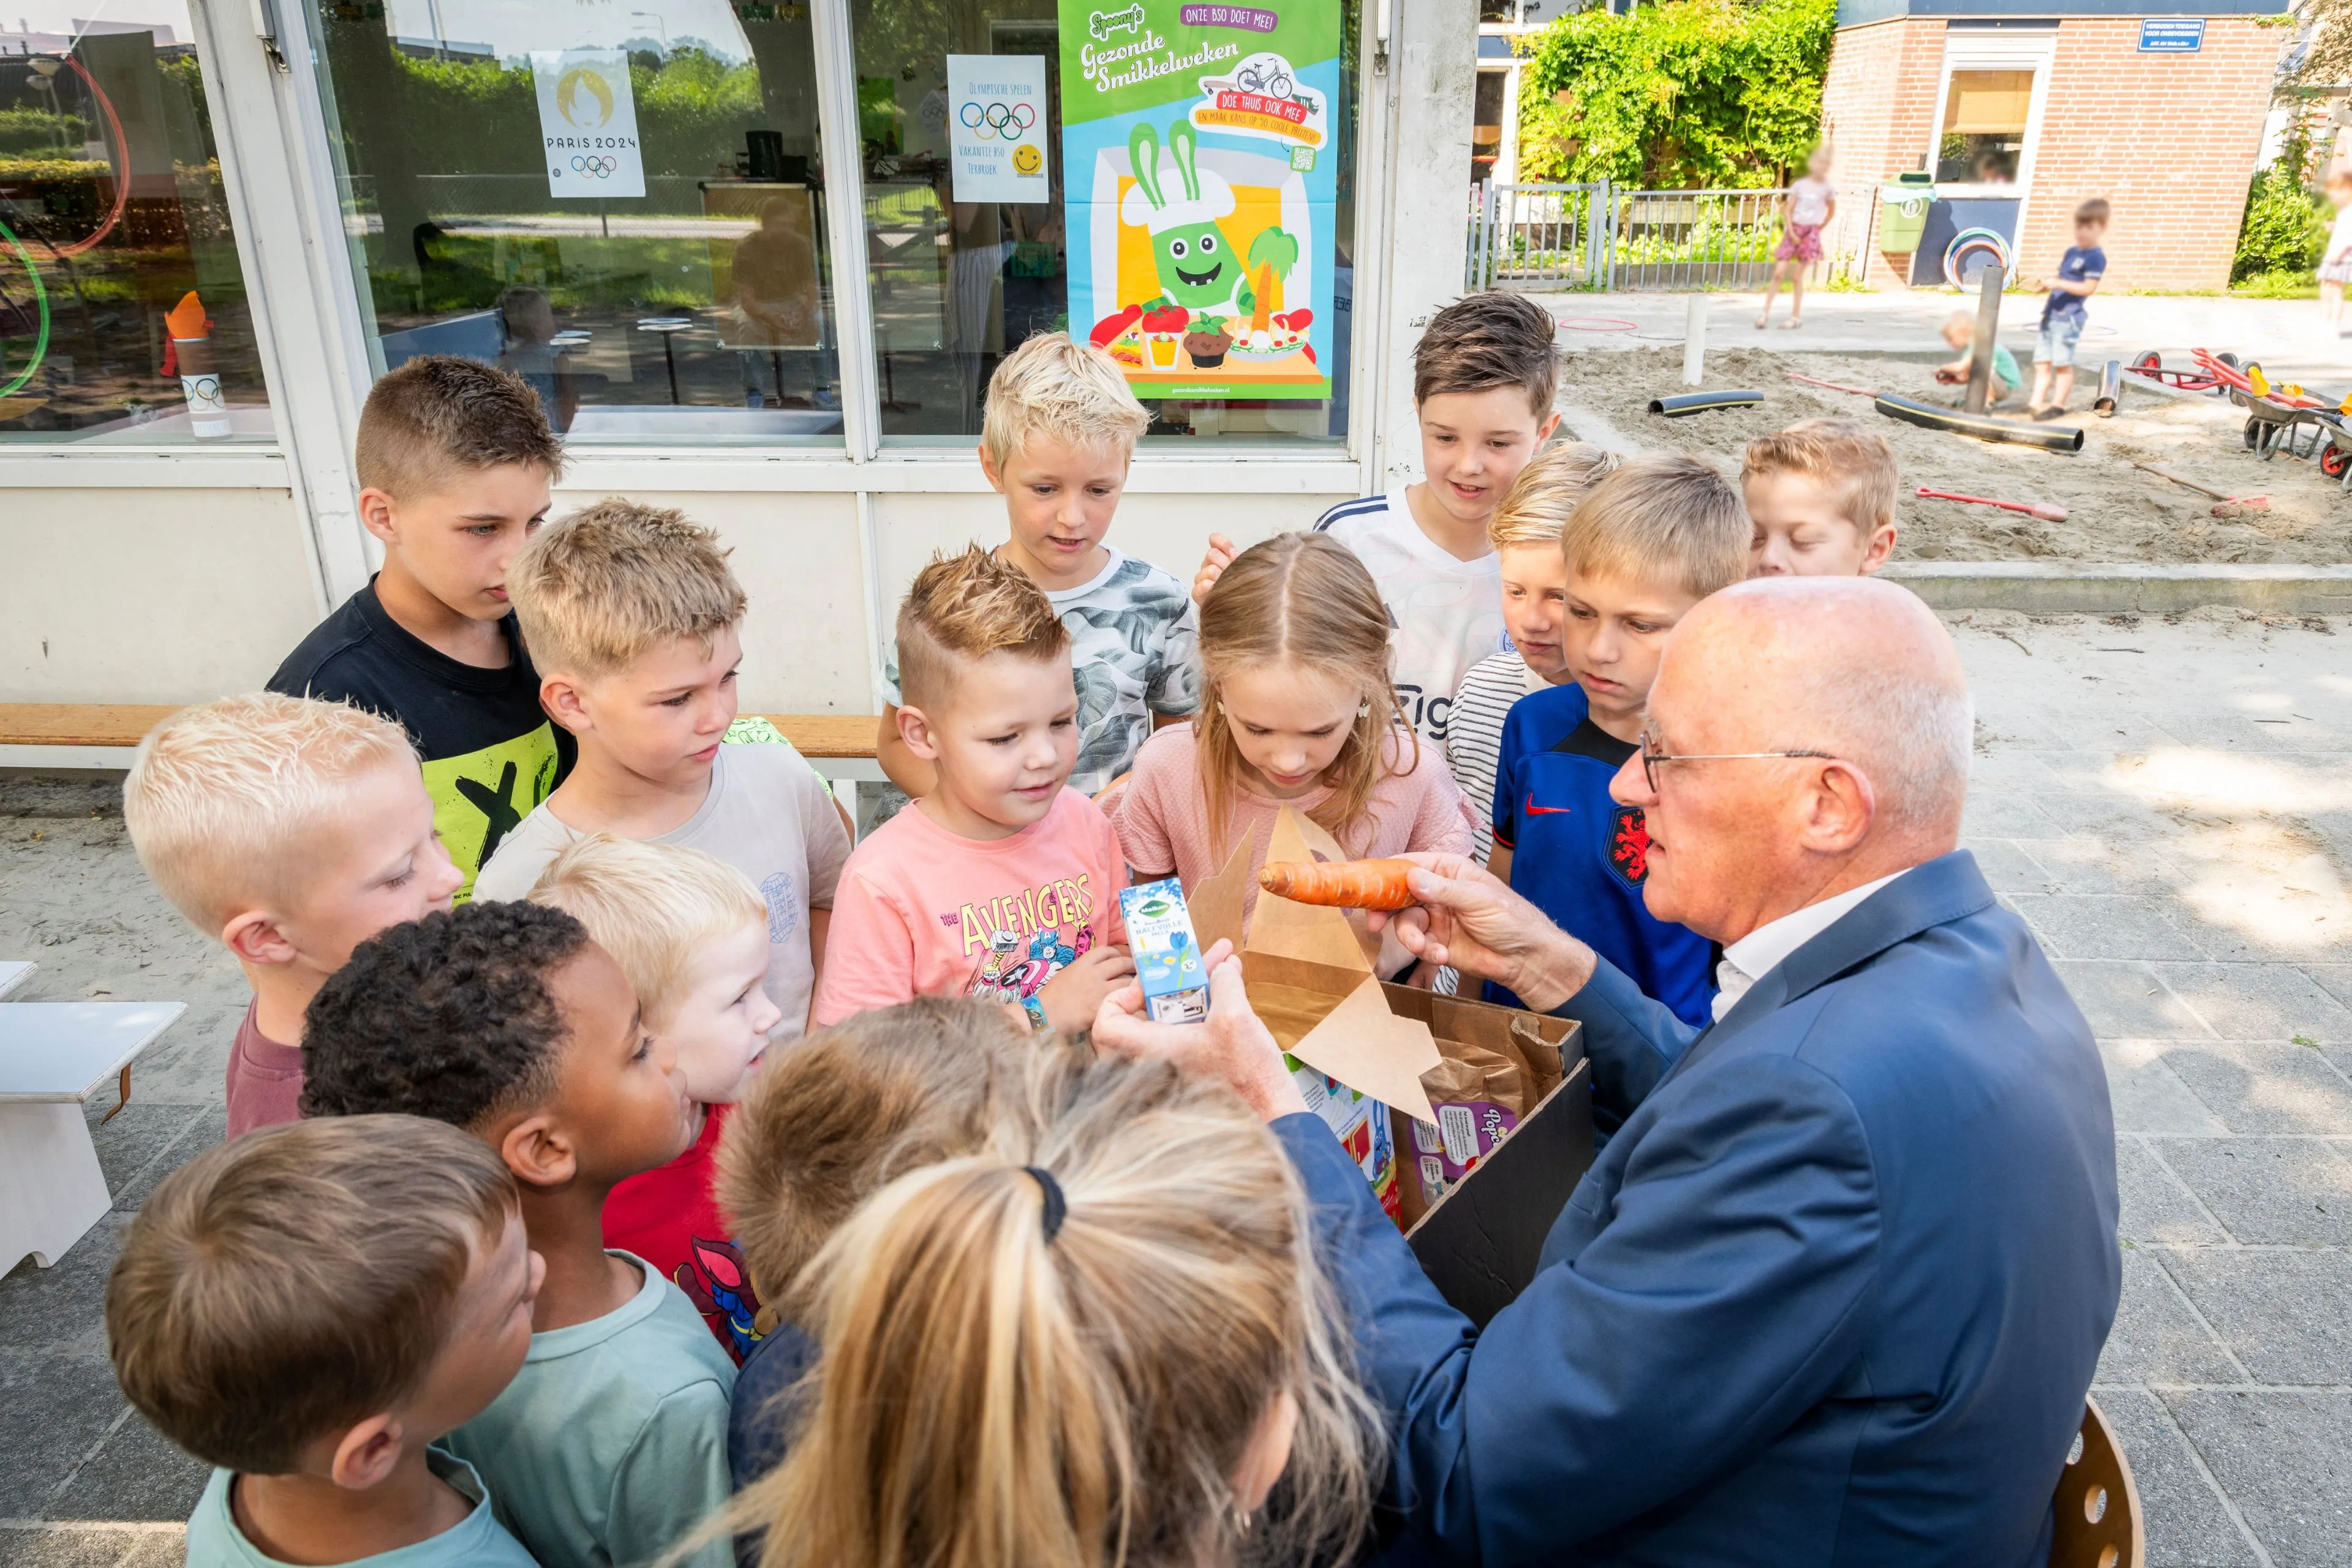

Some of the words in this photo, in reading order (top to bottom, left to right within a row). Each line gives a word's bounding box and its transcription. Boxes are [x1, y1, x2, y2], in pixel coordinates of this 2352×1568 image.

[1091, 6, 1142, 39] Spoony's
[1186, 9, 1207, 22] ONZE
[1212, 8, 1227, 21] BSO
[1231, 9, 1250, 24] DOET
[1253, 13, 1273, 30] MEE!
[1080, 29, 1166, 80] Gezonde
[1095, 41, 1240, 92] Smikkelweken
[968, 81, 1009, 95] OLYMPISCHE
[1010, 83, 1032, 96] SPELEN
[1222, 94, 1237, 108] DOE
[1242, 96, 1262, 111] THUIS
[1265, 100, 1283, 115] OOK
[1284, 105, 1302, 121] MEE
[1199, 112, 1207, 121] EN
[1210, 111, 1227, 122] MAAK
[1230, 113, 1246, 124] KANS
[1249, 116, 1257, 125] OP
[1260, 118, 1268, 127] 50
[1270, 120, 1289, 133] COOLE
[1291, 126, 1316, 143] PRIJZEN!
[596, 138, 636, 148] 2024
[959, 145, 992, 157] VAKANTIE
[993, 146, 1005, 157] BSO
[967, 162, 997, 175] TERBROEK
[940, 913, 959, 926] THE
[960, 873, 1095, 957] AVENGERS
